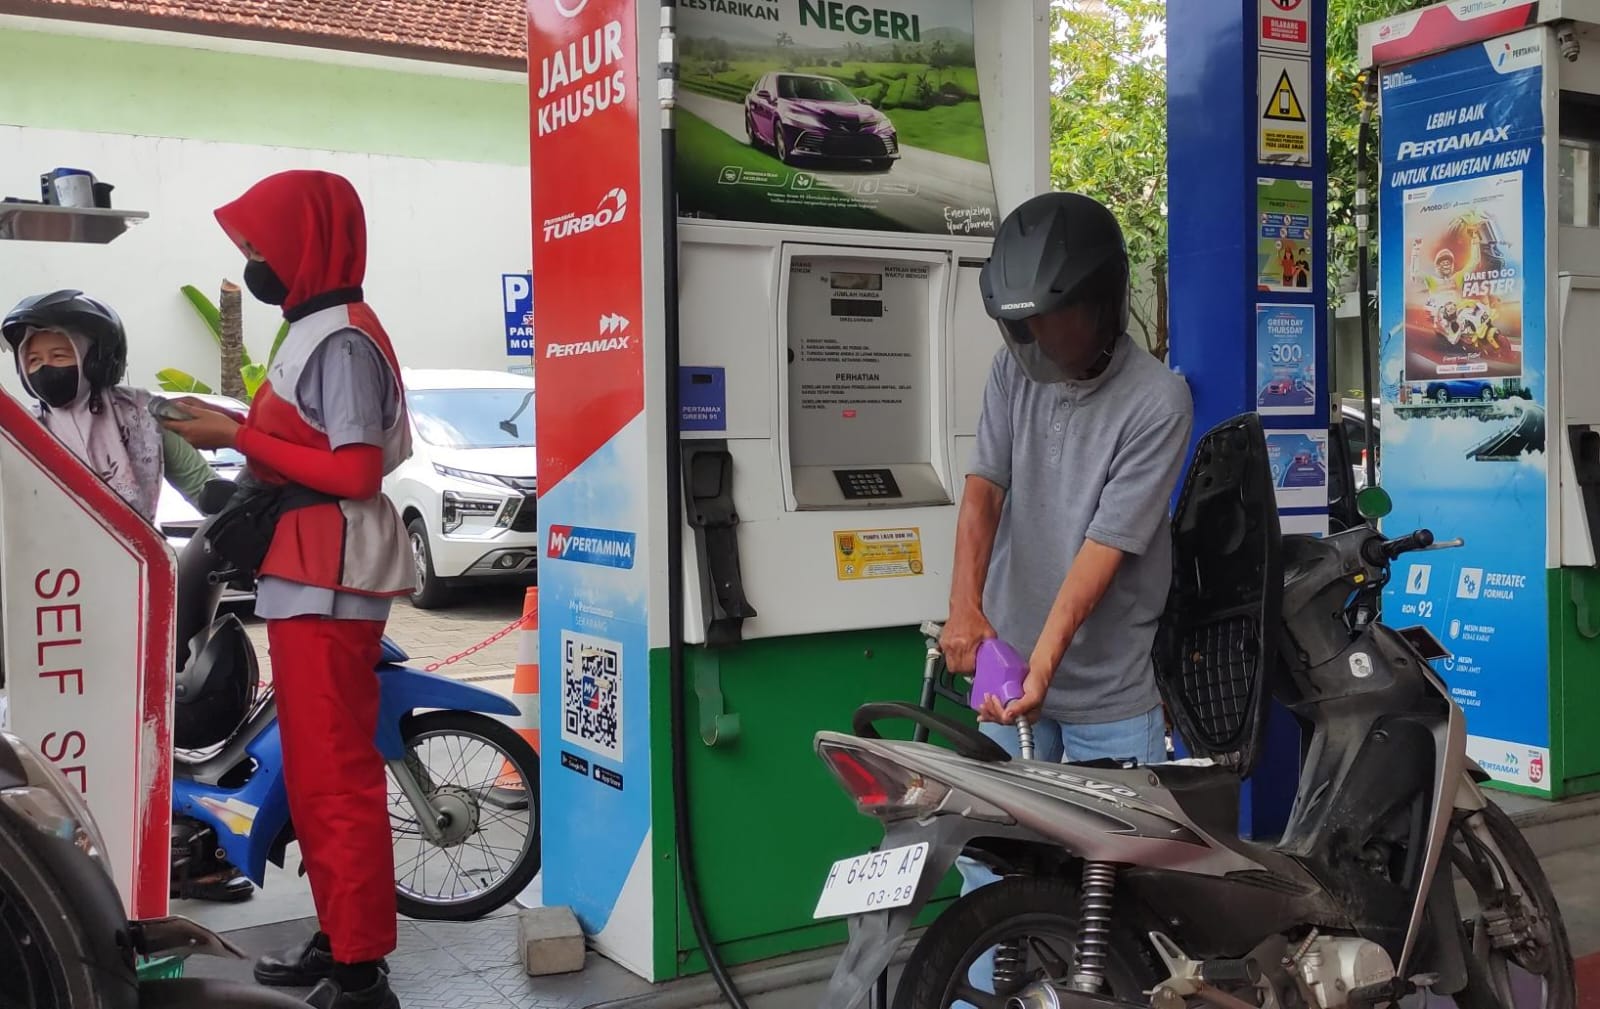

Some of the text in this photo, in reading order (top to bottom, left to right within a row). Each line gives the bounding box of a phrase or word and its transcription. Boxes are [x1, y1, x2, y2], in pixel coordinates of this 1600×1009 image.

[799, 0, 921, 42] NEGERI
[538, 20, 624, 98] JALUR
[538, 70, 626, 136] KHUSUS
[1426, 103, 1486, 131] LEBIH BAIK
[1398, 125, 1511, 160] PERTAMAX
[1391, 147, 1531, 188] UNTUK KEAWETAN MESIN
[944, 206, 992, 220] Energizing
[543, 208, 613, 243] TURBO
[946, 218, 995, 235] Your Journey
[1464, 268, 1516, 282] DARE TO GO
[504, 276, 529, 313] P
[1463, 279, 1514, 298] FASTER
[1001, 301, 1035, 310] HONDA
[546, 336, 630, 358] PERTAMAX
[1271, 344, 1302, 363] 300
[835, 373, 880, 381] PERHATIAN
[1485, 573, 1526, 588] PERTATEC
[1483, 588, 1514, 600] FORMULA
[1418, 600, 1432, 617] 92
[35, 568, 83, 695] SELF
[1479, 760, 1520, 775] PERTAMAX
[826, 846, 923, 889] H 6455 AP
